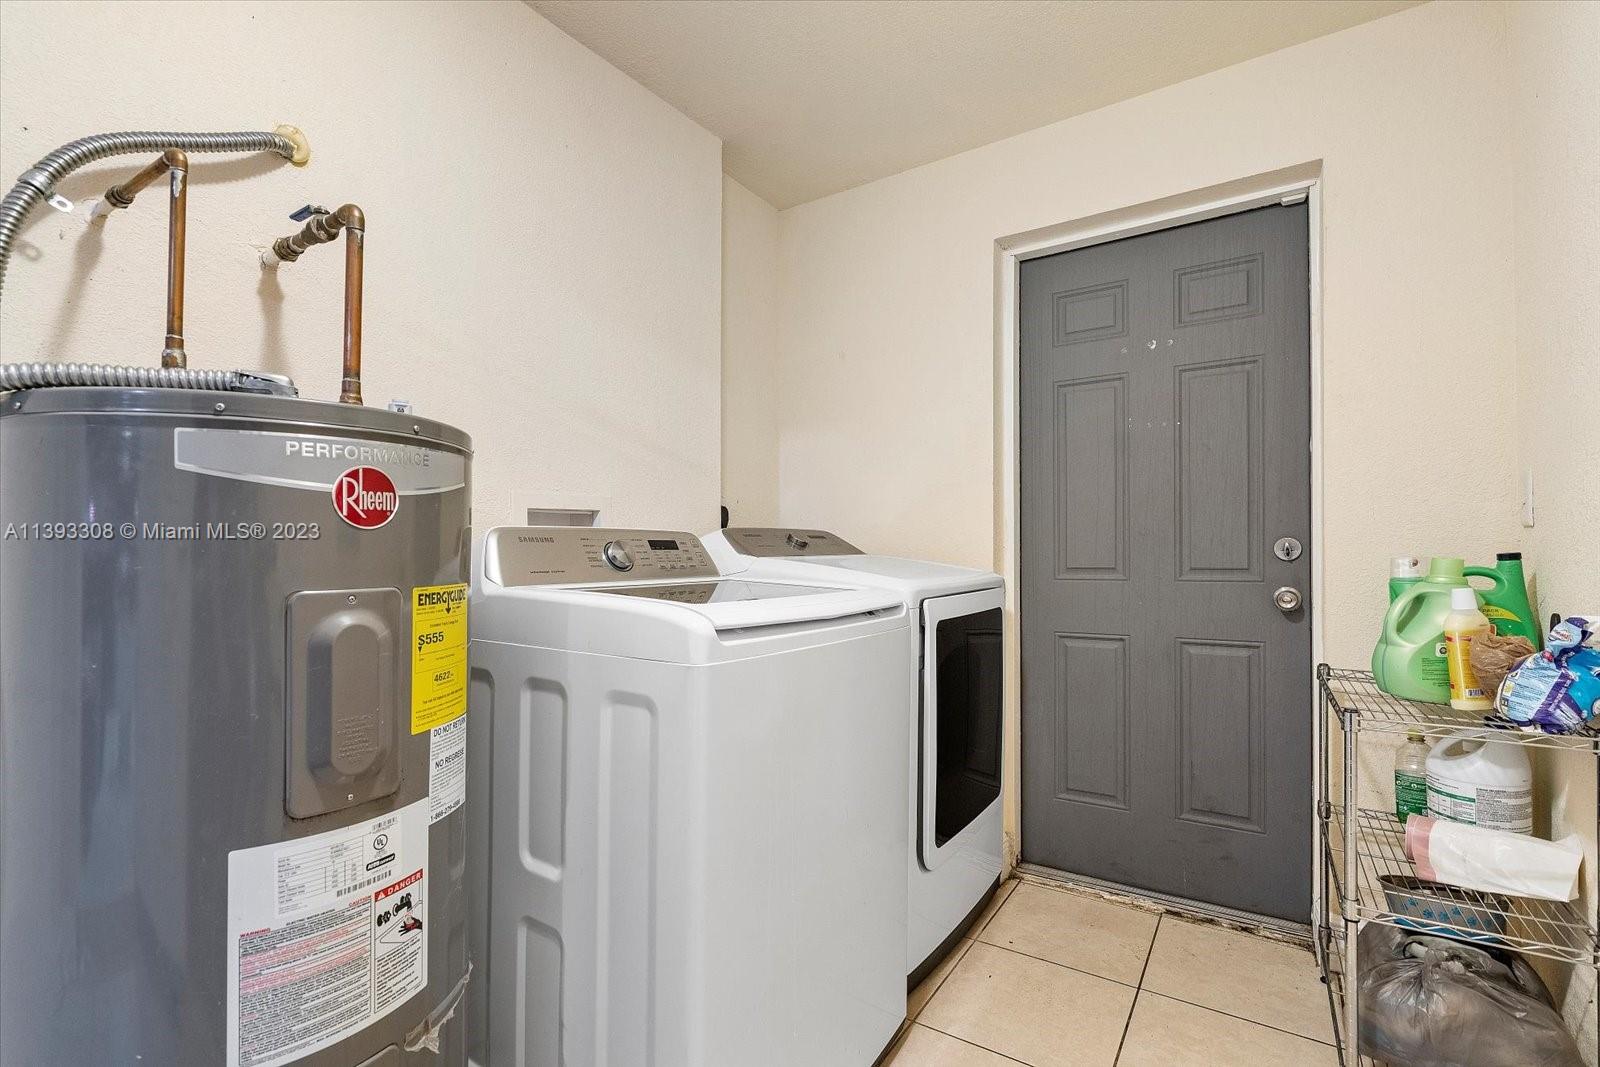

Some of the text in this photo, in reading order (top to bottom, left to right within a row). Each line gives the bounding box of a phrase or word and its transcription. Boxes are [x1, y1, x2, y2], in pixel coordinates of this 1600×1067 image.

[285, 440, 430, 467] PERFORMANCE
[342, 467, 395, 519] Rheem
[518, 536, 555, 544] SAMSUNG
[417, 631, 444, 646] $555
[433, 727, 442, 737] DO
[442, 722, 453, 733] NOT
[434, 758, 444, 769] NO
[387, 872, 421, 894] DANGER
